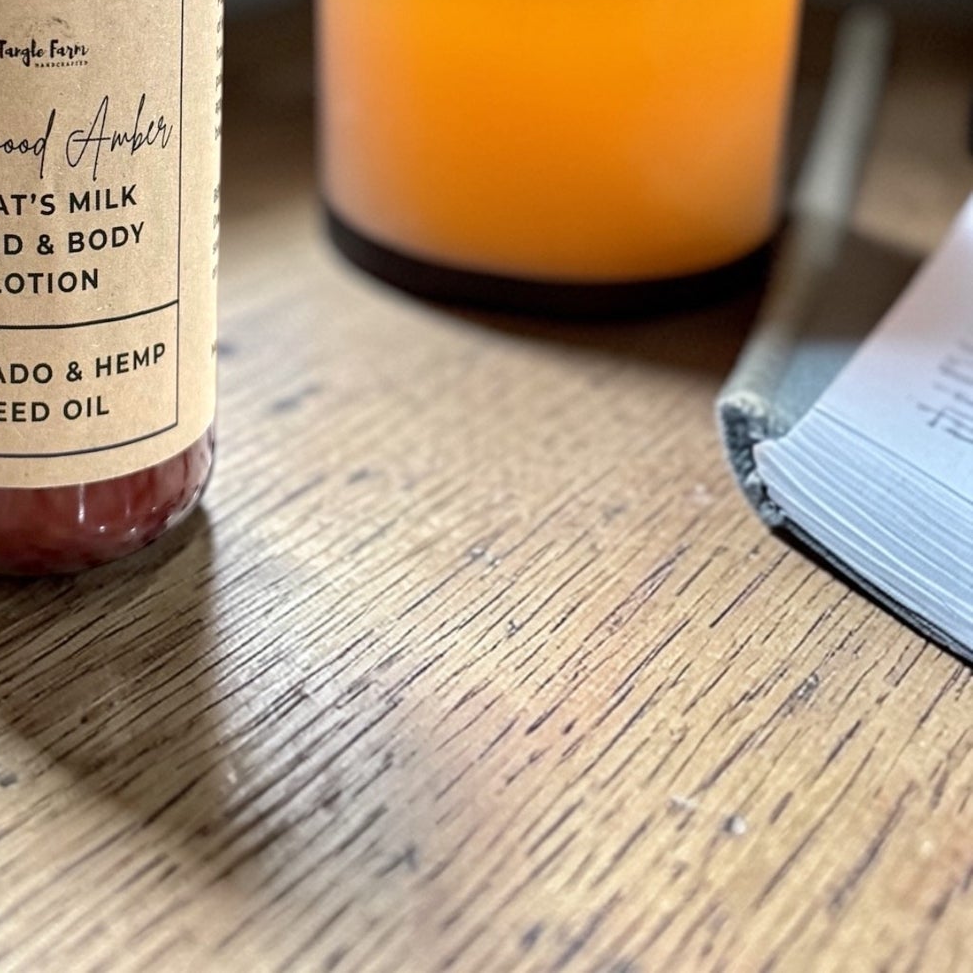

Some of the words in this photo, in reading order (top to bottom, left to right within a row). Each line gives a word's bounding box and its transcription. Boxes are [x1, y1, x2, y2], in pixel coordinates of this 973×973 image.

[34, 60, 89, 68] HANDCRAFTED
[49, 38, 89, 59] Farm
[65, 92, 174, 182] Amber
[68, 183, 138, 214] MILK
[36, 233, 55, 256] &
[67, 221, 145, 254] BODY
[65, 360, 83, 383] &
[95, 342, 166, 379] HEMP
[62, 395, 110, 421] OIL
